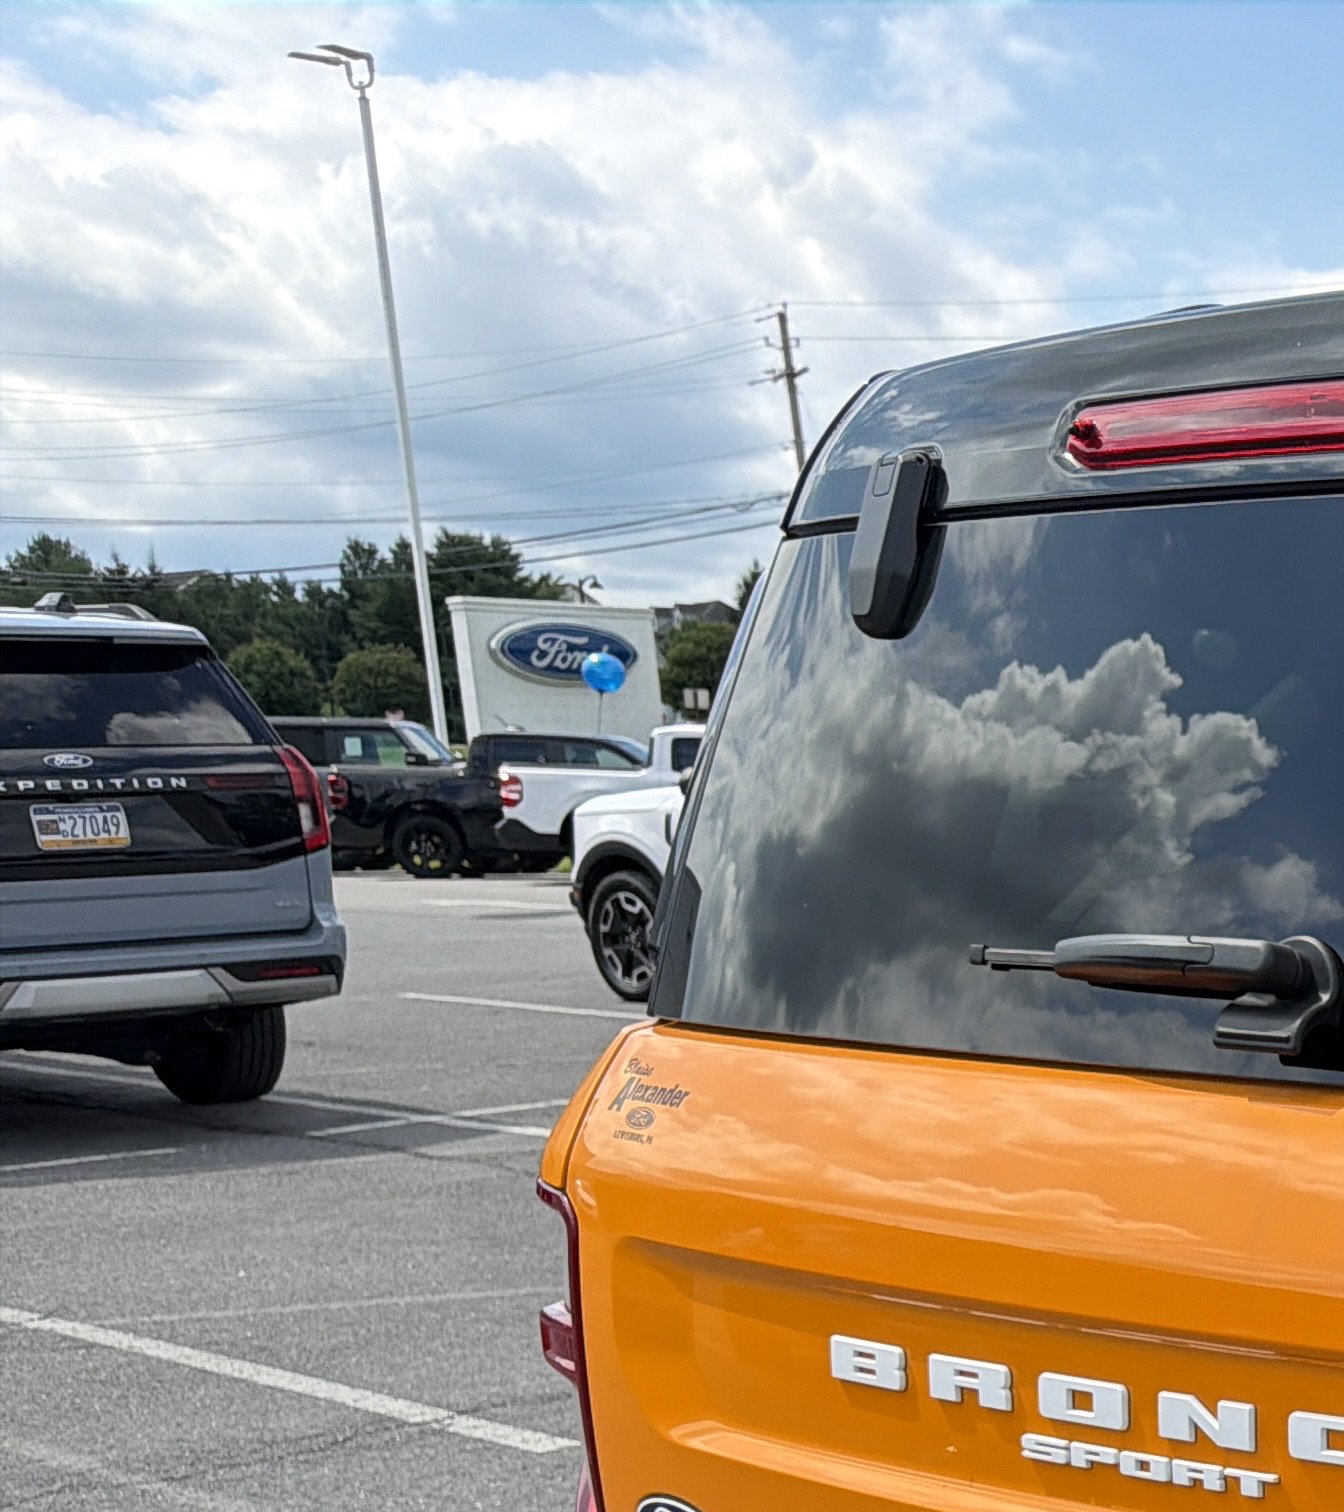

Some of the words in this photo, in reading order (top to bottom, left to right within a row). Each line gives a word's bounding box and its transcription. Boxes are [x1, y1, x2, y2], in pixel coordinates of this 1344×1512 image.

[530, 632, 610, 670] For
[68, 815, 121, 837] 27049
[608, 1076, 691, 1112] Alexander
[1019, 1432, 1281, 1498] SPORT
